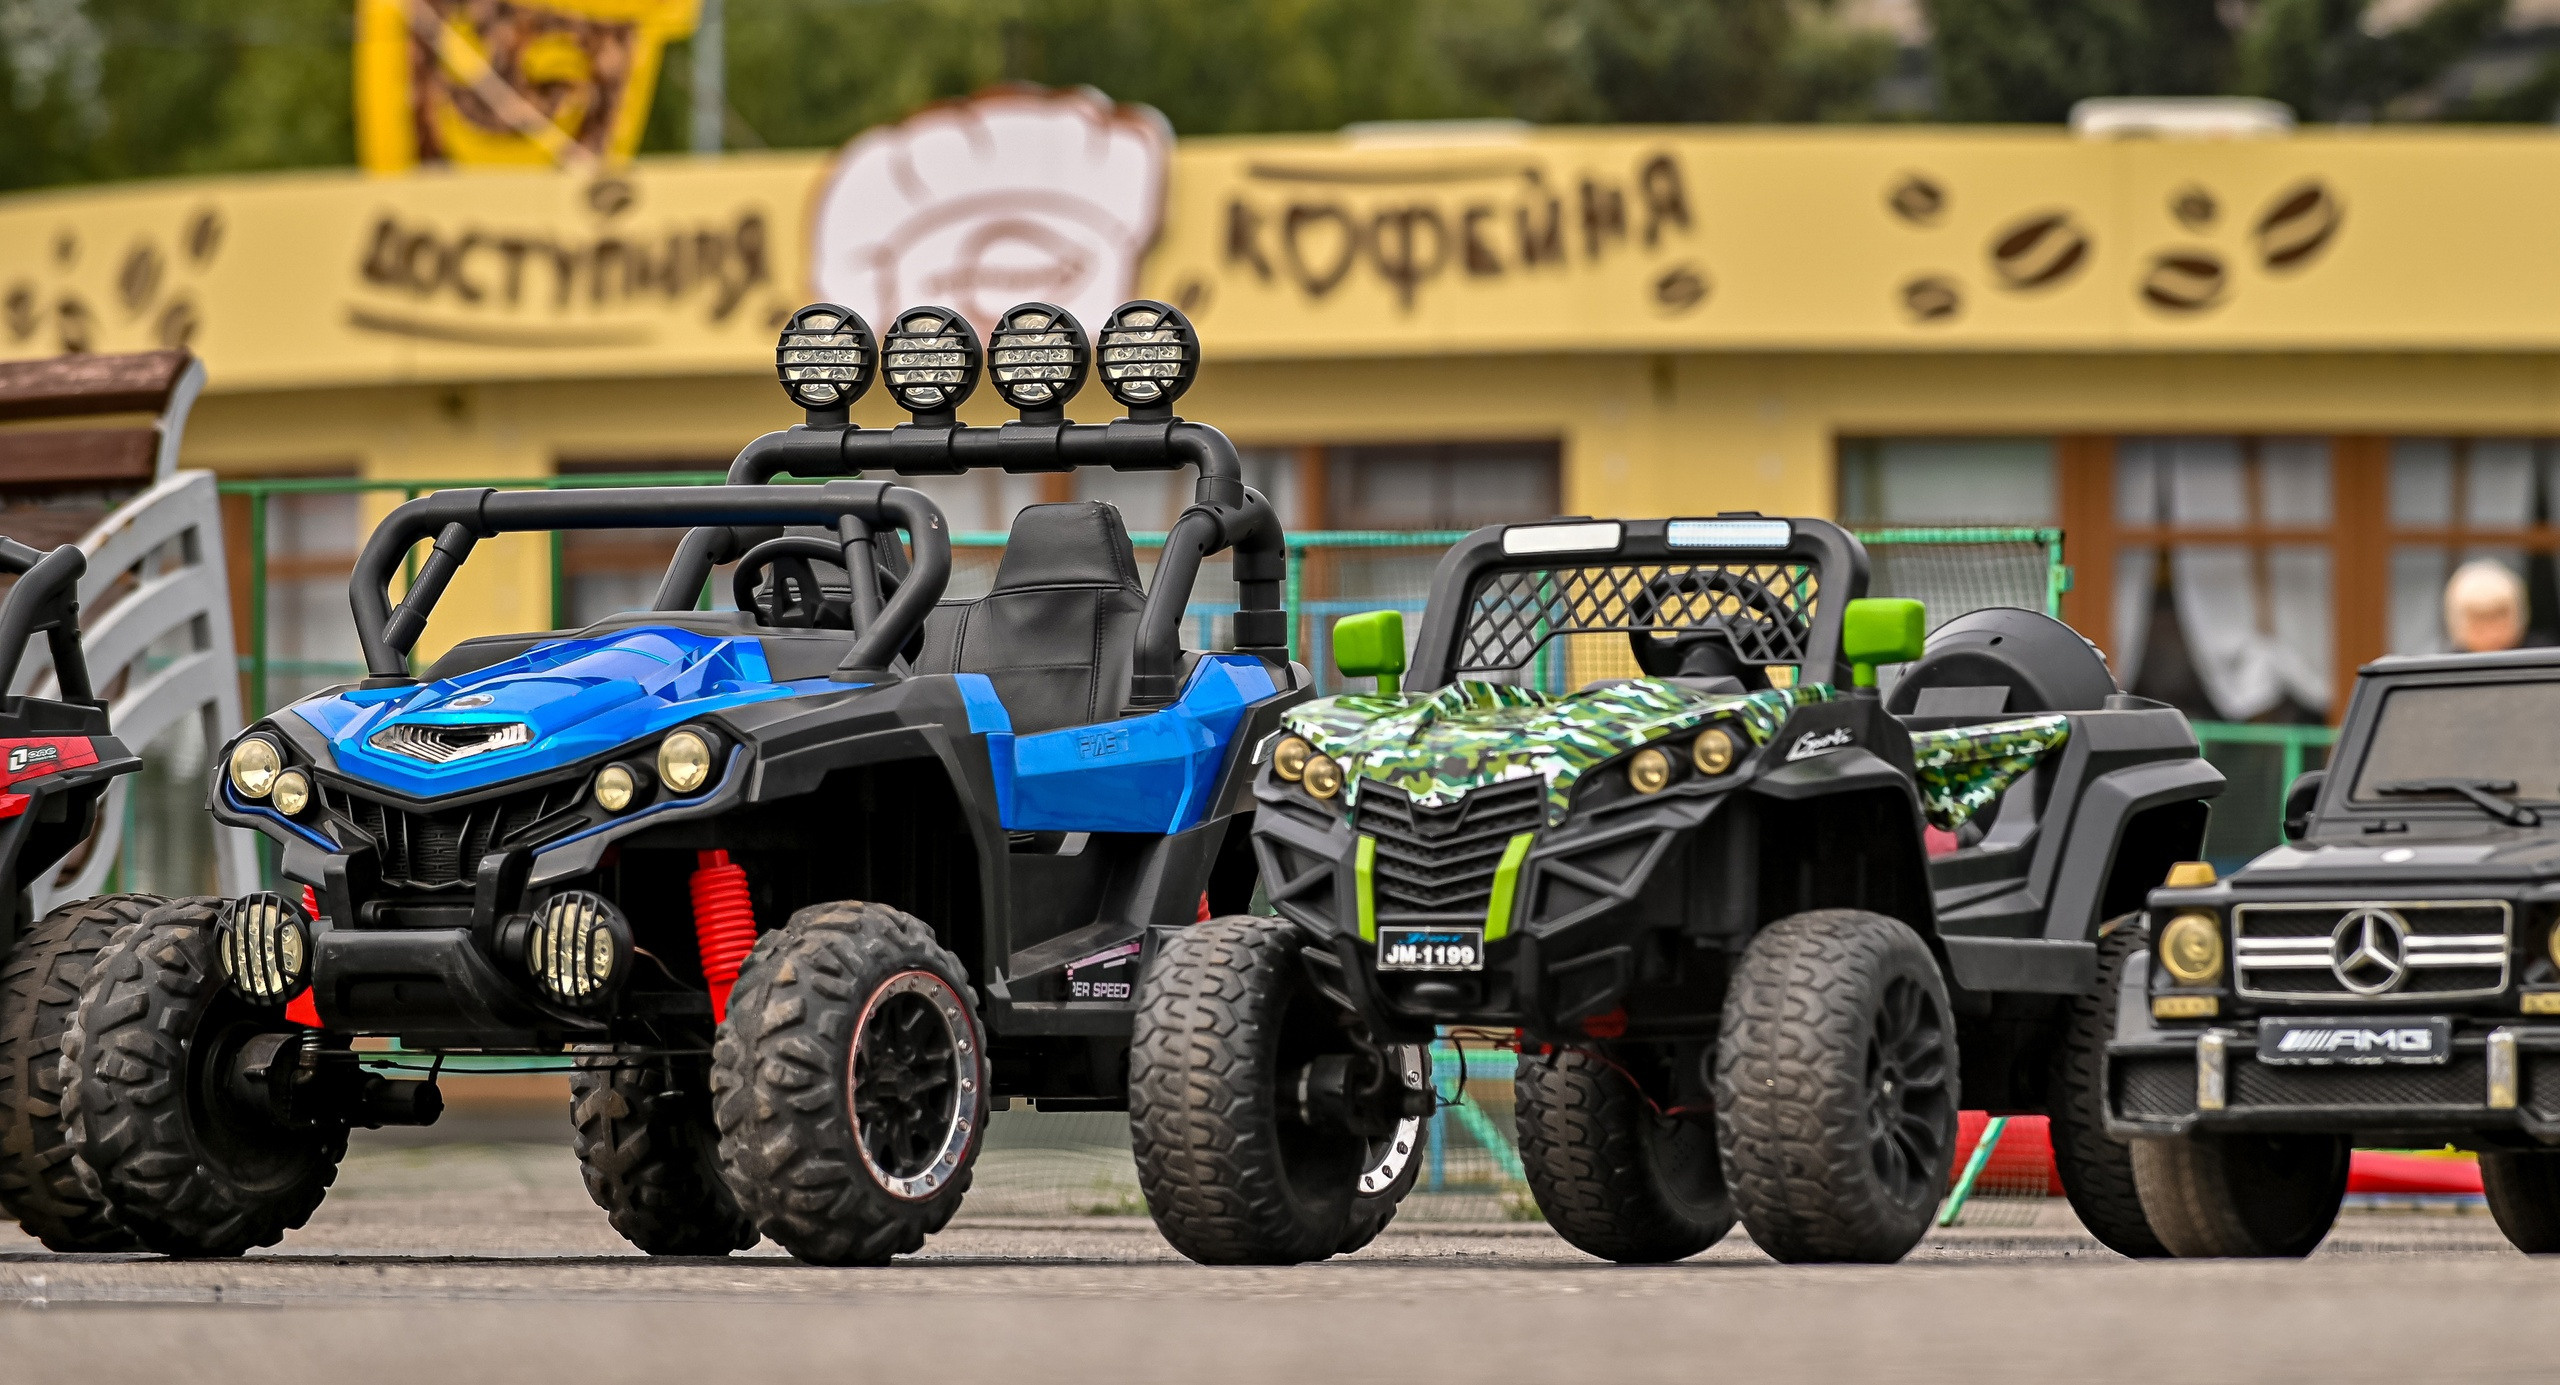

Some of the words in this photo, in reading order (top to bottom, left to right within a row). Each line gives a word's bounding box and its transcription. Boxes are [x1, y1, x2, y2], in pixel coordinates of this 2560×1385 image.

[1223, 152, 1694, 312] КОФЕЙНЯ
[1384, 943, 1475, 966] JM-1199
[1092, 982, 1131, 999] SPEED
[2322, 1028, 2433, 1052] AMG
